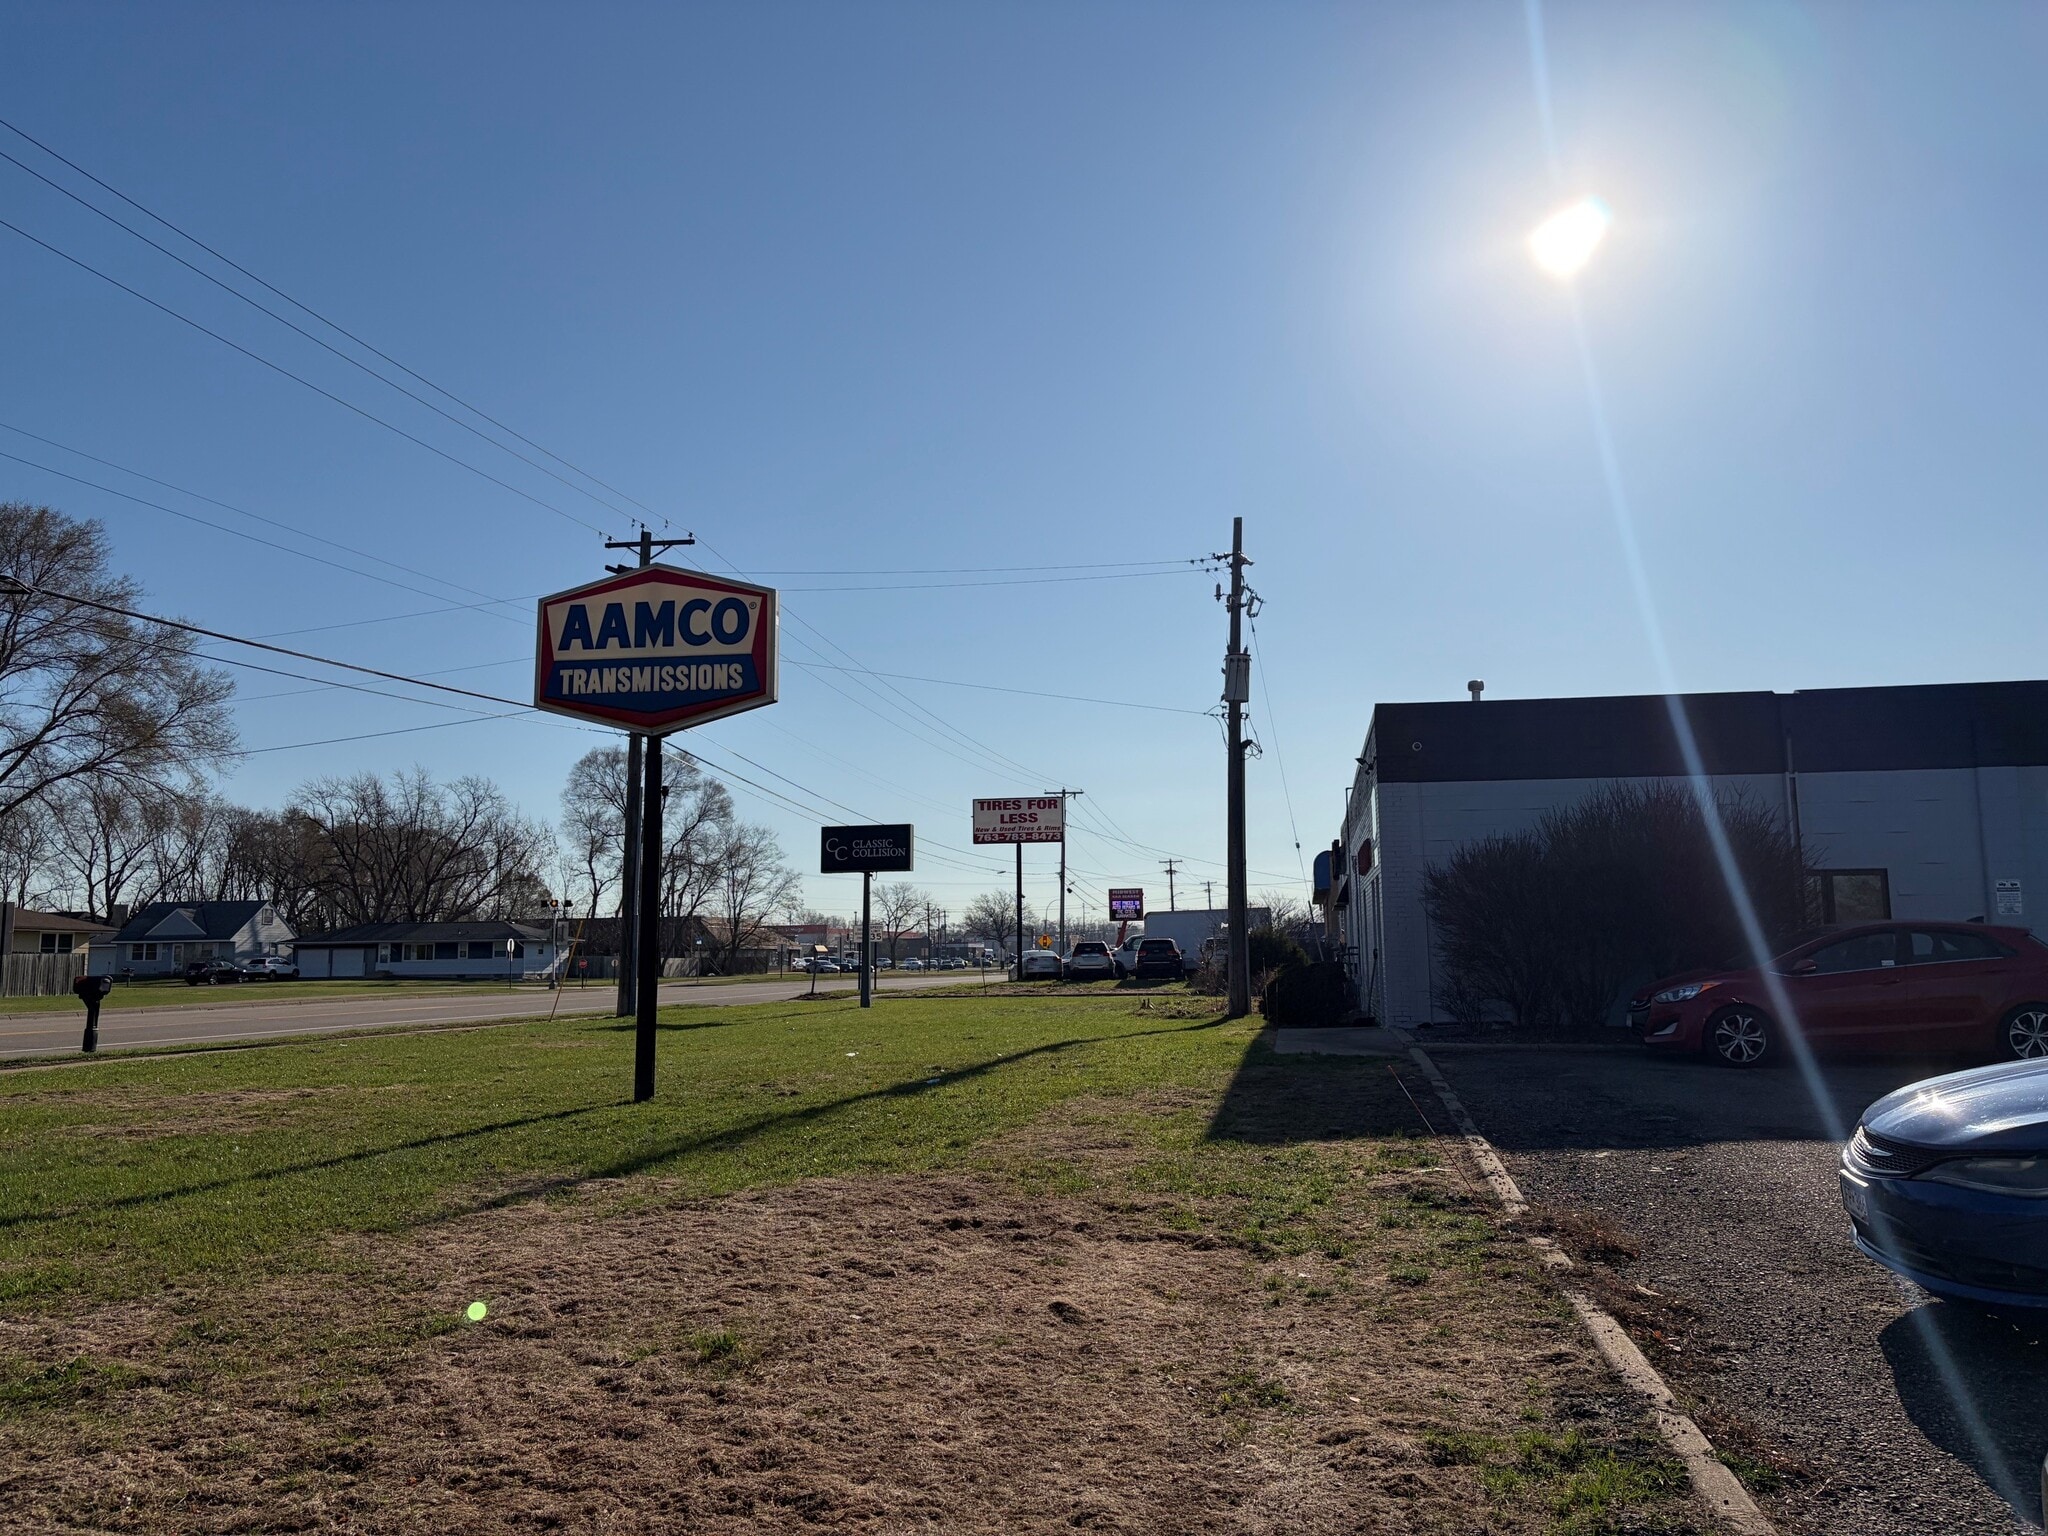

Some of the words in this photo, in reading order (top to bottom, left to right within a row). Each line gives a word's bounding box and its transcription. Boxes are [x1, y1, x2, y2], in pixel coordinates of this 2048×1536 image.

[558, 597, 750, 651] AAMCO
[560, 663, 743, 695] TRANSMISSIONS
[977, 800, 1022, 811] TIRES
[1027, 799, 1058, 810] FOR
[1000, 812, 1039, 824] LESS
[976, 832, 1061, 842] 763-783-8473
[852, 838, 893, 848] CLASSIC
[852, 848, 906, 858] COLLISION
[870, 932, 882, 940] 35
